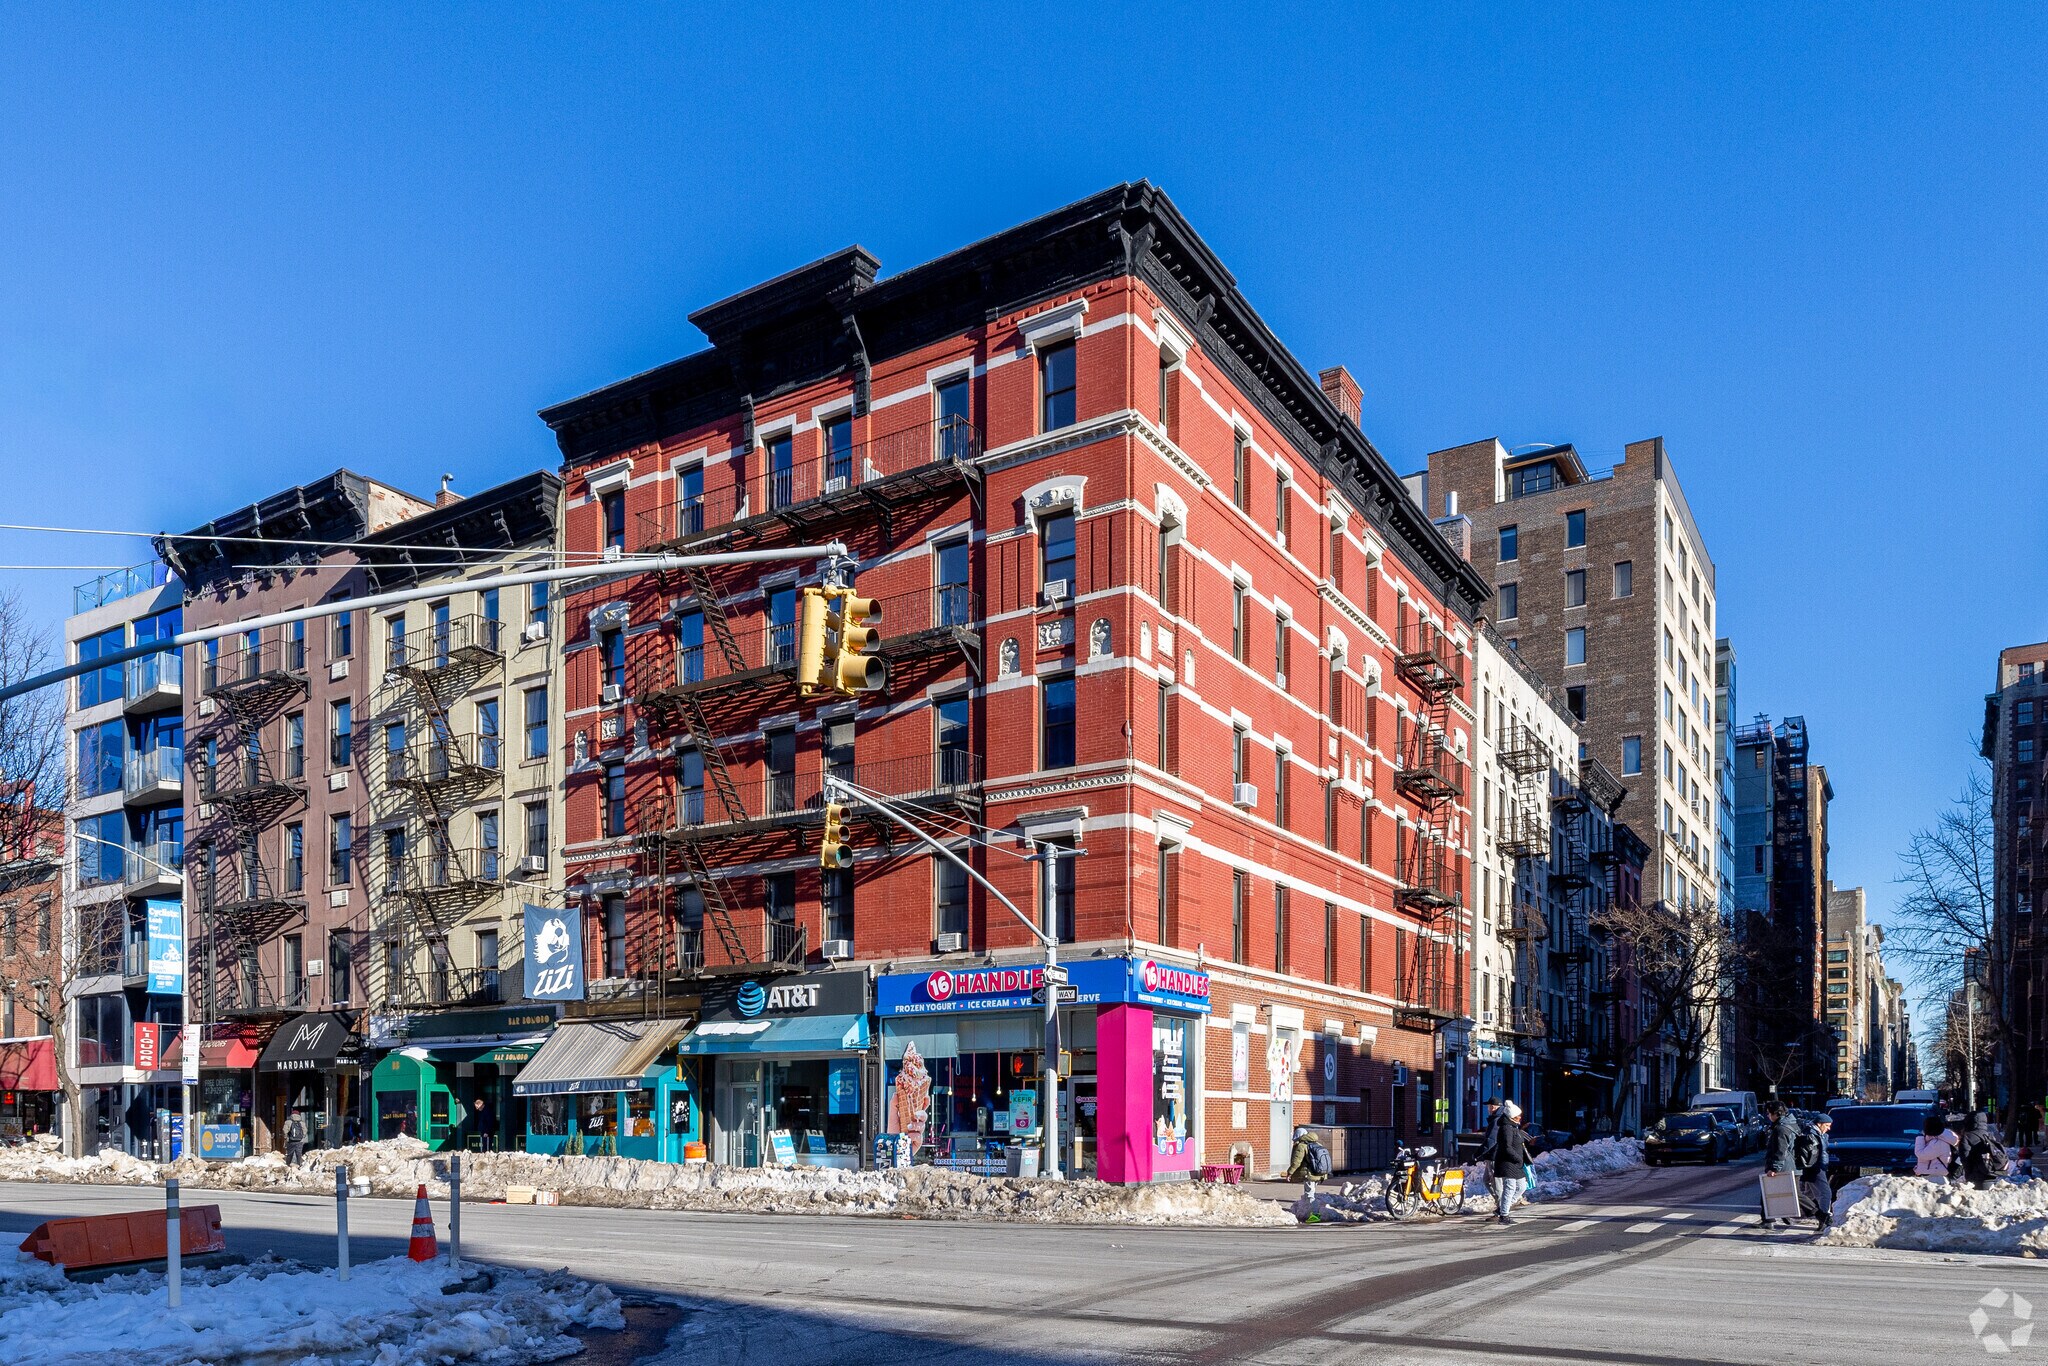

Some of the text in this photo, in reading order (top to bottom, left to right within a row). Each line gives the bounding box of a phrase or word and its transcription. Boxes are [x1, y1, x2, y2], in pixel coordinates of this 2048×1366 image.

[929, 968, 1045, 997] 16 HANDLE
[1145, 966, 1209, 996] 16 HANDLES
[767, 984, 821, 1008] AT&T
[895, 993, 1101, 1013] FROZEN YOGURT ICE CREAM VE ERVE
[1058, 990, 1073, 998] WAY
[508, 1016, 520, 1026] BAR
[140, 1027, 154, 1067] LIQUORS
[277, 1060, 315, 1070] MARDANA
[214, 1132, 239, 1143] SUN'S UP
